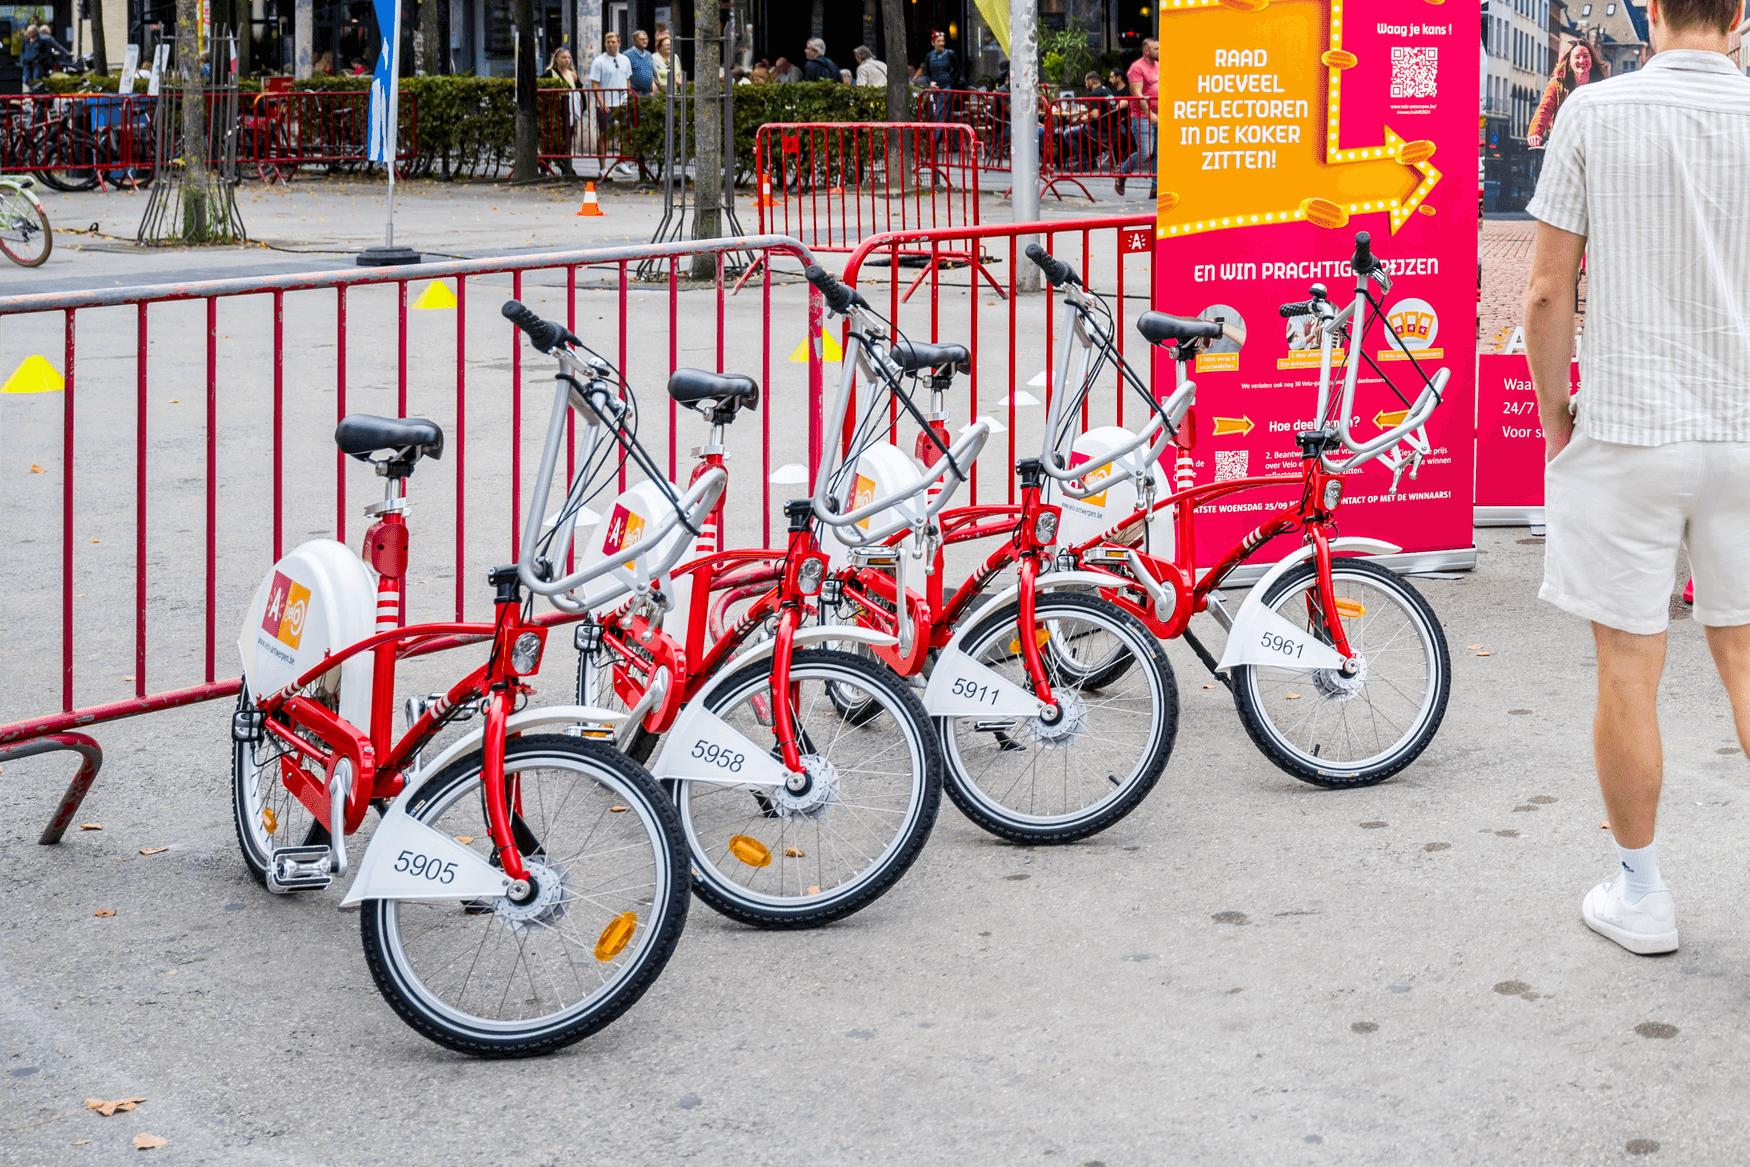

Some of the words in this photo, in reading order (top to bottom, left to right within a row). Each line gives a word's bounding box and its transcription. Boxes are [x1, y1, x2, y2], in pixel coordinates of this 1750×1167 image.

[1377, 23, 1407, 37] Waag
[1408, 23, 1420, 37] je
[1422, 23, 1447, 35] kans
[1215, 49, 1267, 68] RAAD
[1198, 74, 1285, 93] HOEVEEL
[1174, 100, 1308, 119] REFLECTOREN
[1180, 126, 1200, 145] IN
[1206, 126, 1230, 144] DE
[1235, 125, 1301, 144] KOKER
[1202, 150, 1276, 170] ZITTEN!
[1194, 264, 1215, 282] EN
[1220, 262, 1256, 280] WIN
[1262, 260, 1357, 279] PRACHTIG
[1503, 402, 1534, 416] 24/7
[1269, 420, 1290, 432] Hoe
[1502, 426, 1532, 438] Voor
[1219, 503, 1263, 513] WOENSDAG
[1264, 501, 1288, 511] 25/09
[1368, 495, 1378, 503] OP
[1397, 493, 1407, 501] DE
[1408, 491, 1452, 501] WINNAARS!
[1260, 631, 1303, 659] 5961
[951, 677, 1000, 706] 5911
[691, 739, 745, 773] 5958
[394, 850, 459, 885] 5905
